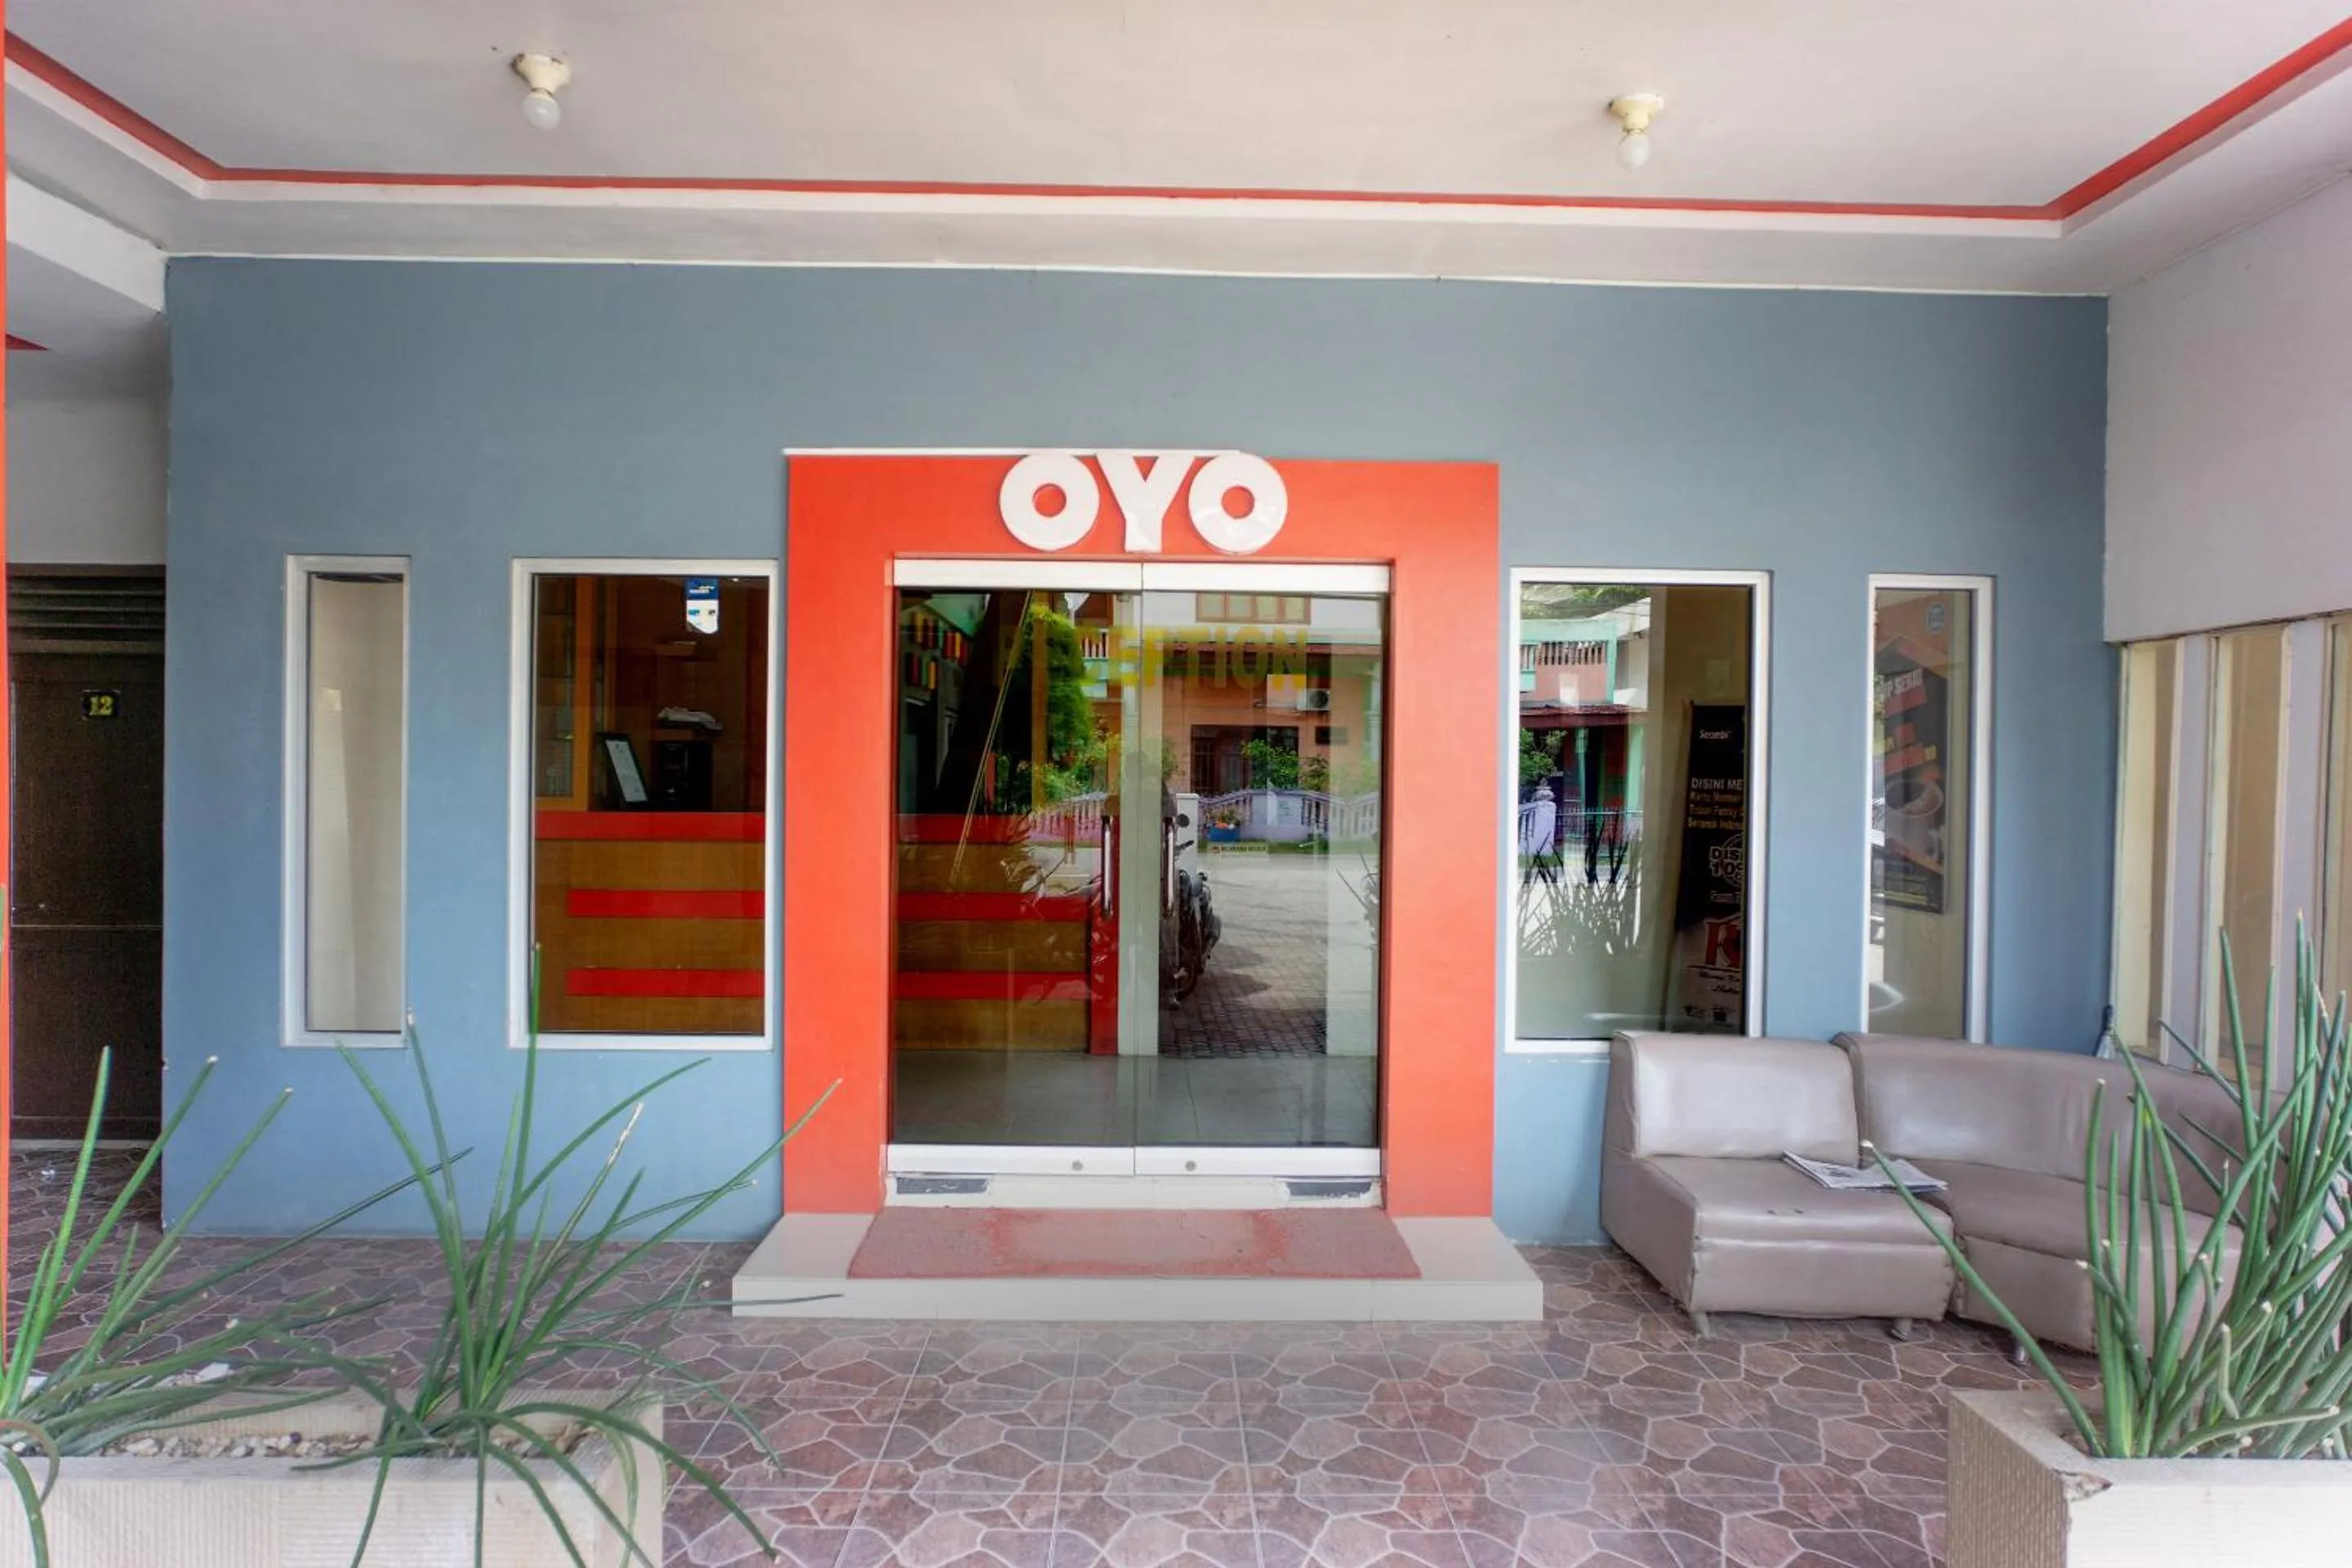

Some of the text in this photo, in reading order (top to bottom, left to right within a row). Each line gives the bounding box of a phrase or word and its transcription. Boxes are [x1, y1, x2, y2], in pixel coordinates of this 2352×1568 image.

[999, 450, 1288, 555] OYO
[89, 695, 114, 716] 12
[1691, 777, 1725, 790] DISINI
